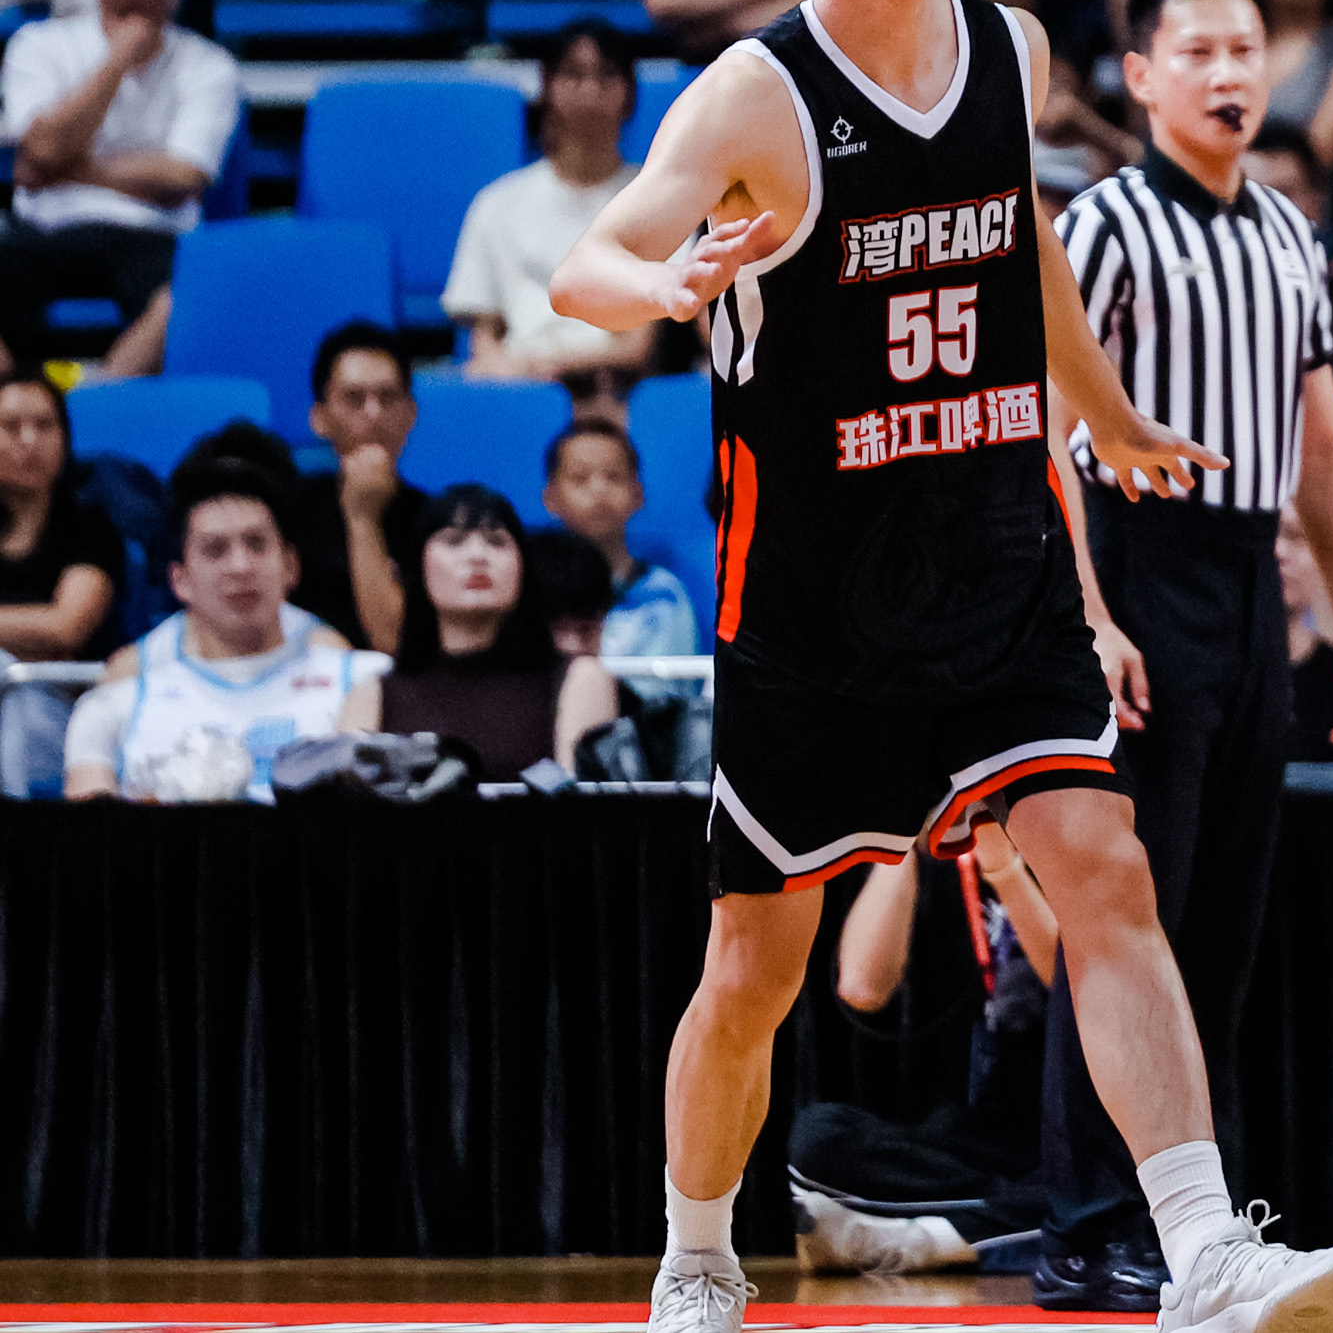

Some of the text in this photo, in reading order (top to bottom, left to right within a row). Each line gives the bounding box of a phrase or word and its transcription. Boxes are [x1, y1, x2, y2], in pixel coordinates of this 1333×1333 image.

[887, 283, 979, 382] 55
[837, 383, 1043, 470] 珠江啤酒
